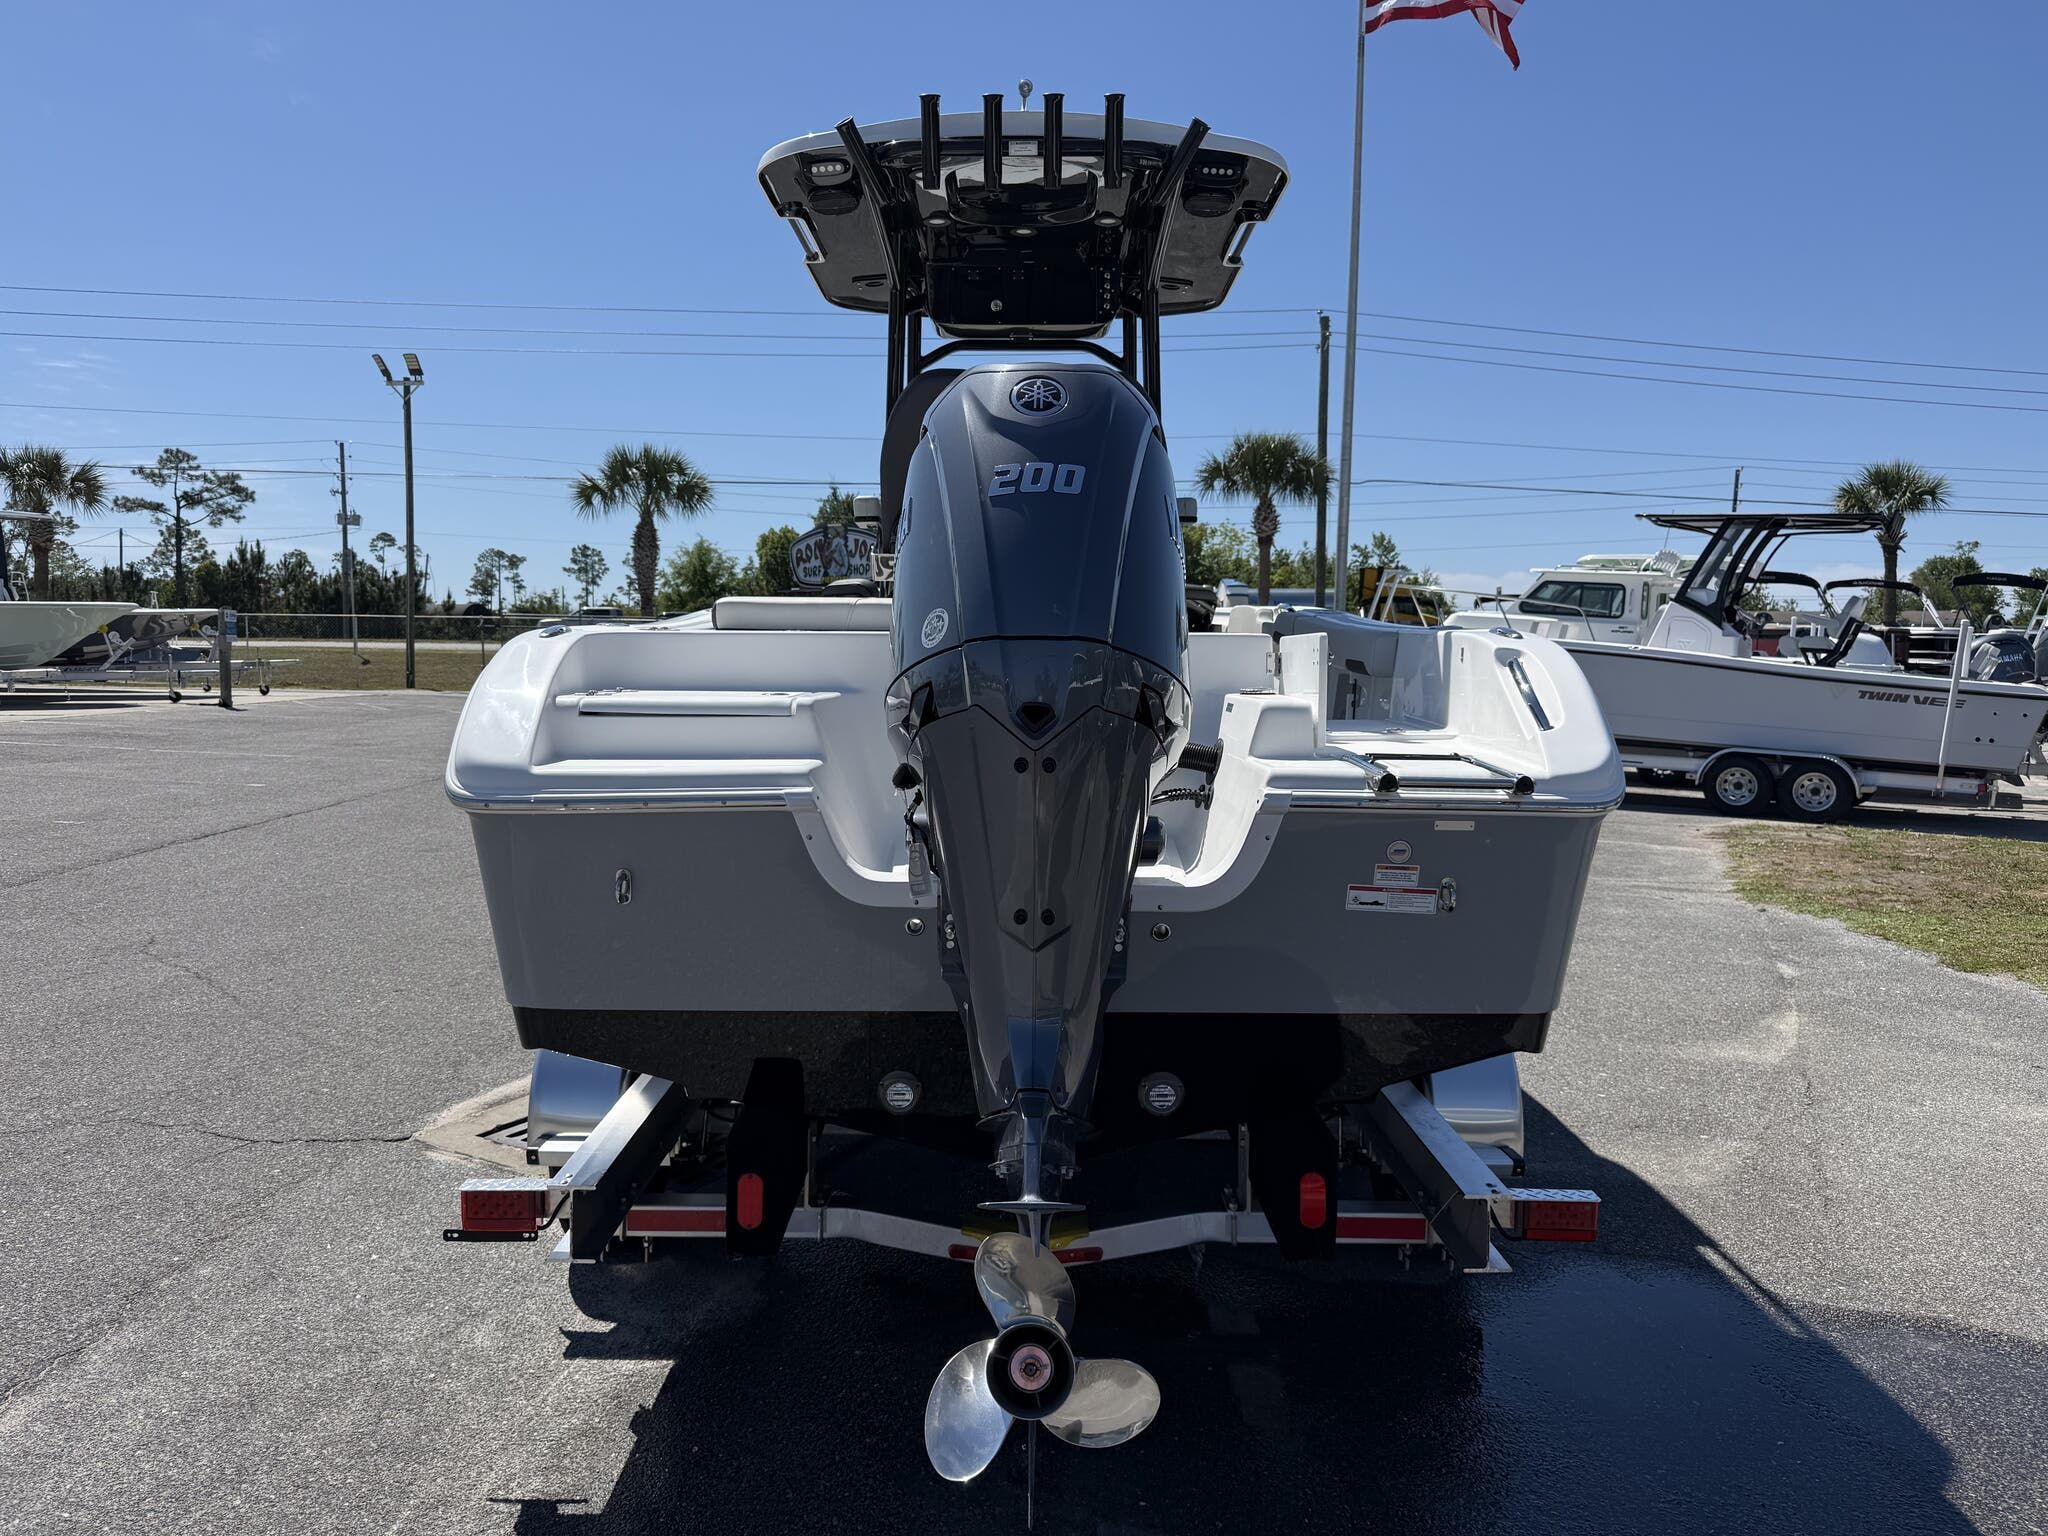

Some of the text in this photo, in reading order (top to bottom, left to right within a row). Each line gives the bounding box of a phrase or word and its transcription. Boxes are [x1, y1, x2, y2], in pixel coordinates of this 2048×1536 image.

[988, 462, 1087, 496] 200
[802, 563, 871, 578] SURF SHOP
[1999, 653, 2024, 664] AMAHA
[1858, 690, 1911, 703] TWIN
